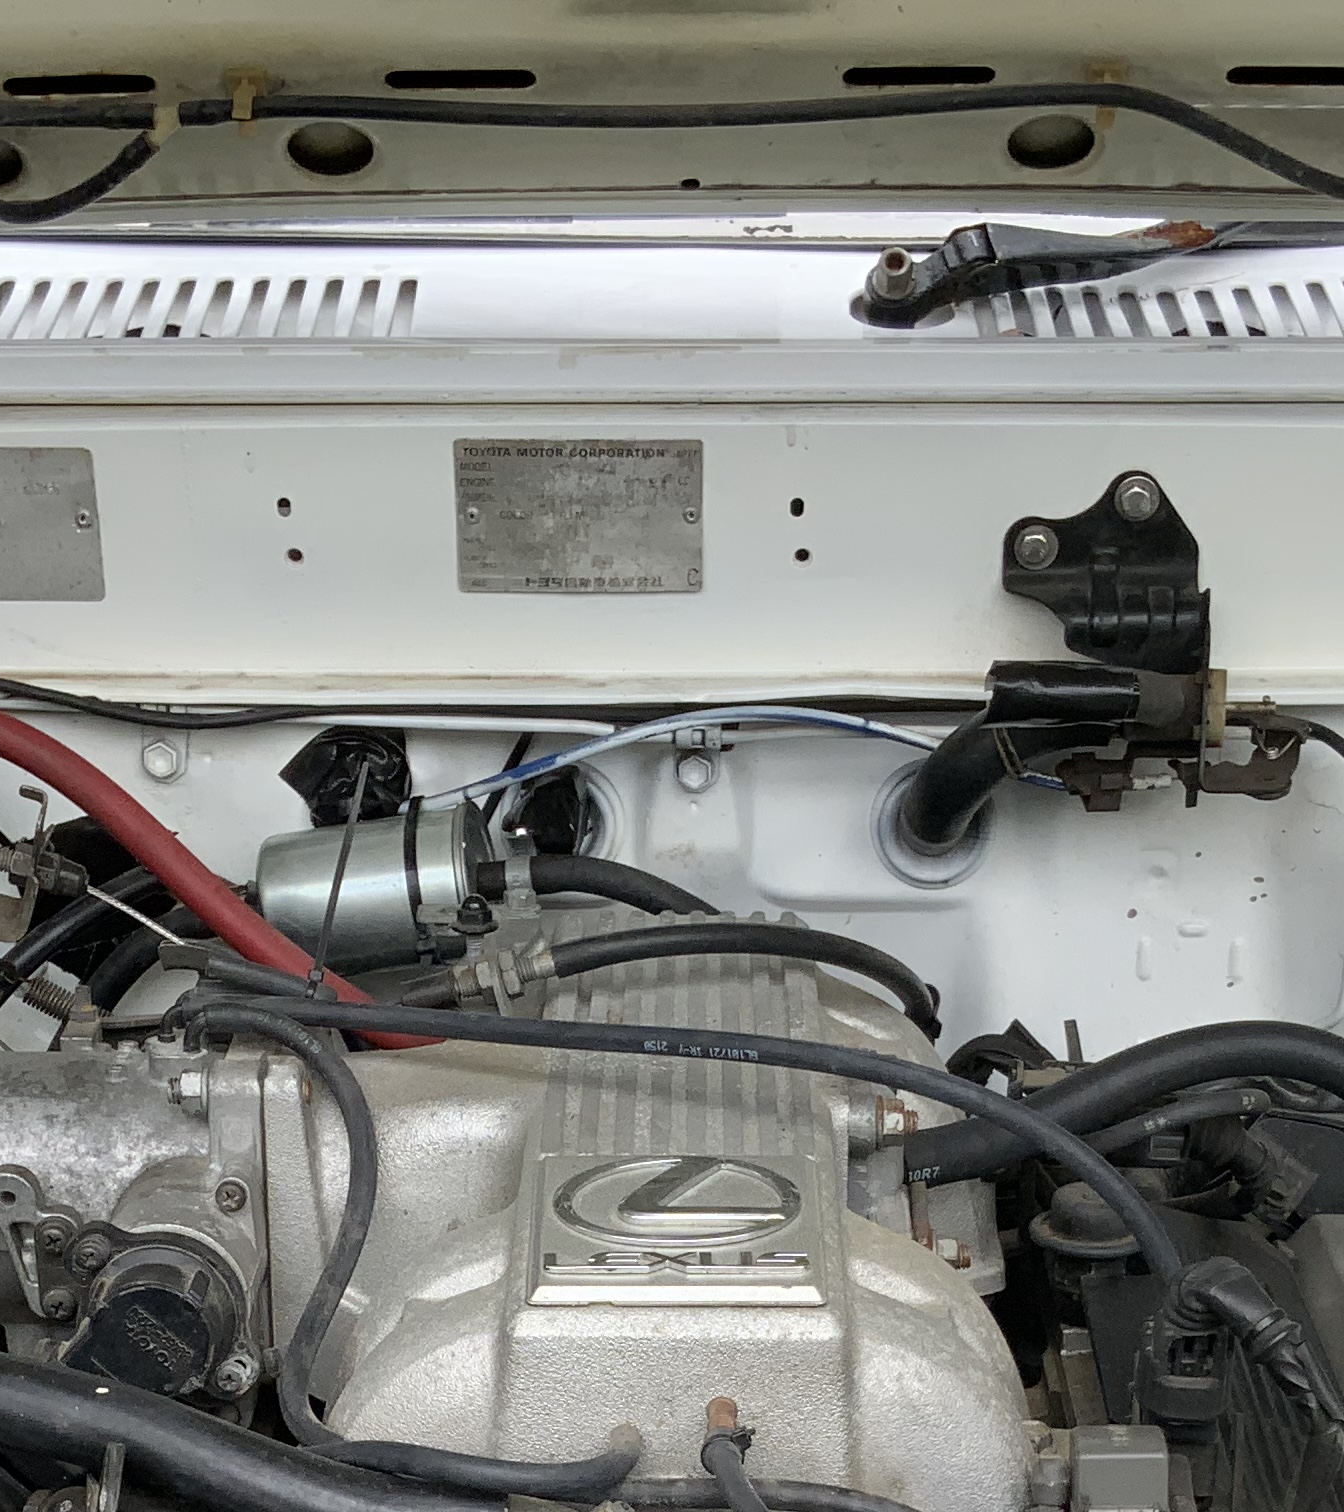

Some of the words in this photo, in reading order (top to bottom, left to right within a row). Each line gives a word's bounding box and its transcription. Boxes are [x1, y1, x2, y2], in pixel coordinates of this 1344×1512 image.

[462, 446, 512, 458] TOYOTA
[515, 447, 564, 458] MOTOR
[568, 447, 666, 459] CORPORATION
